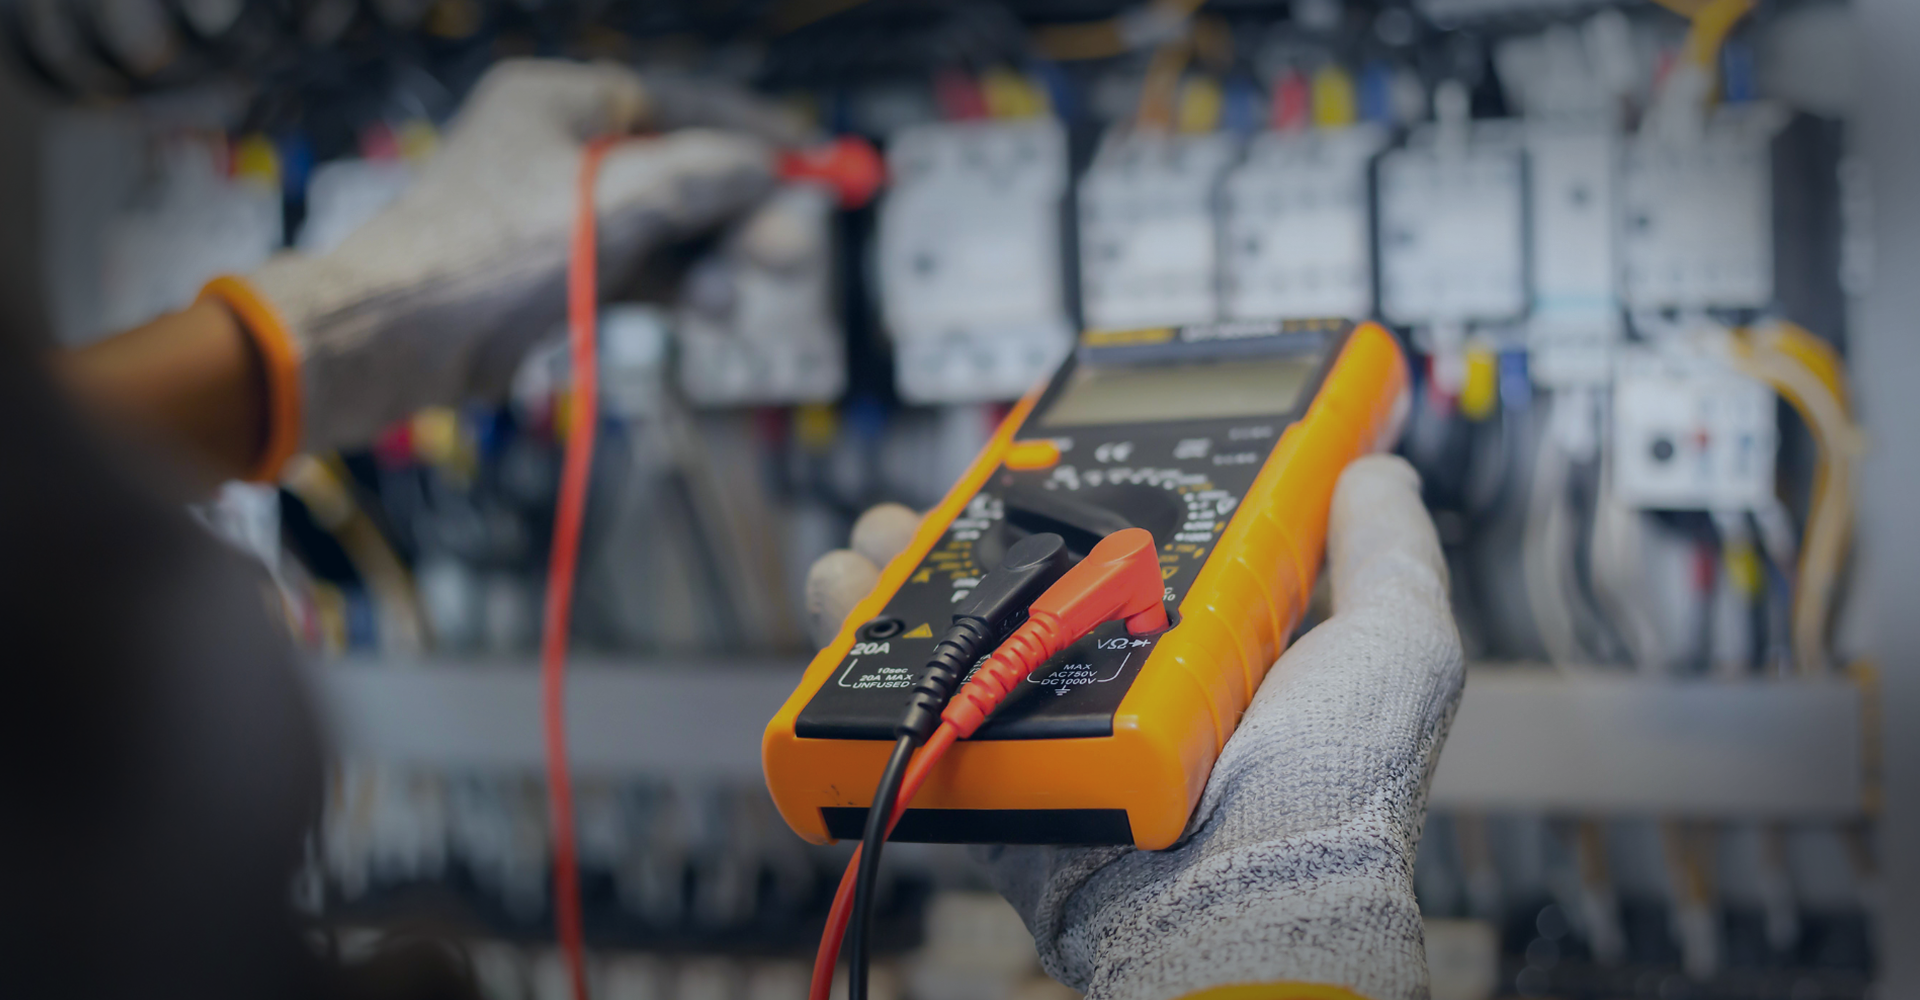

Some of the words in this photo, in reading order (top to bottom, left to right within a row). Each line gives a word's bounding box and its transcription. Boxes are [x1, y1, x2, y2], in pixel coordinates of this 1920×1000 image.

[850, 641, 890, 655] 20A
[859, 674, 881, 682] 20A
[1048, 670, 1098, 678] AC750V
[852, 681, 910, 689] UNFUSED
[1041, 677, 1097, 685] DC1000V
